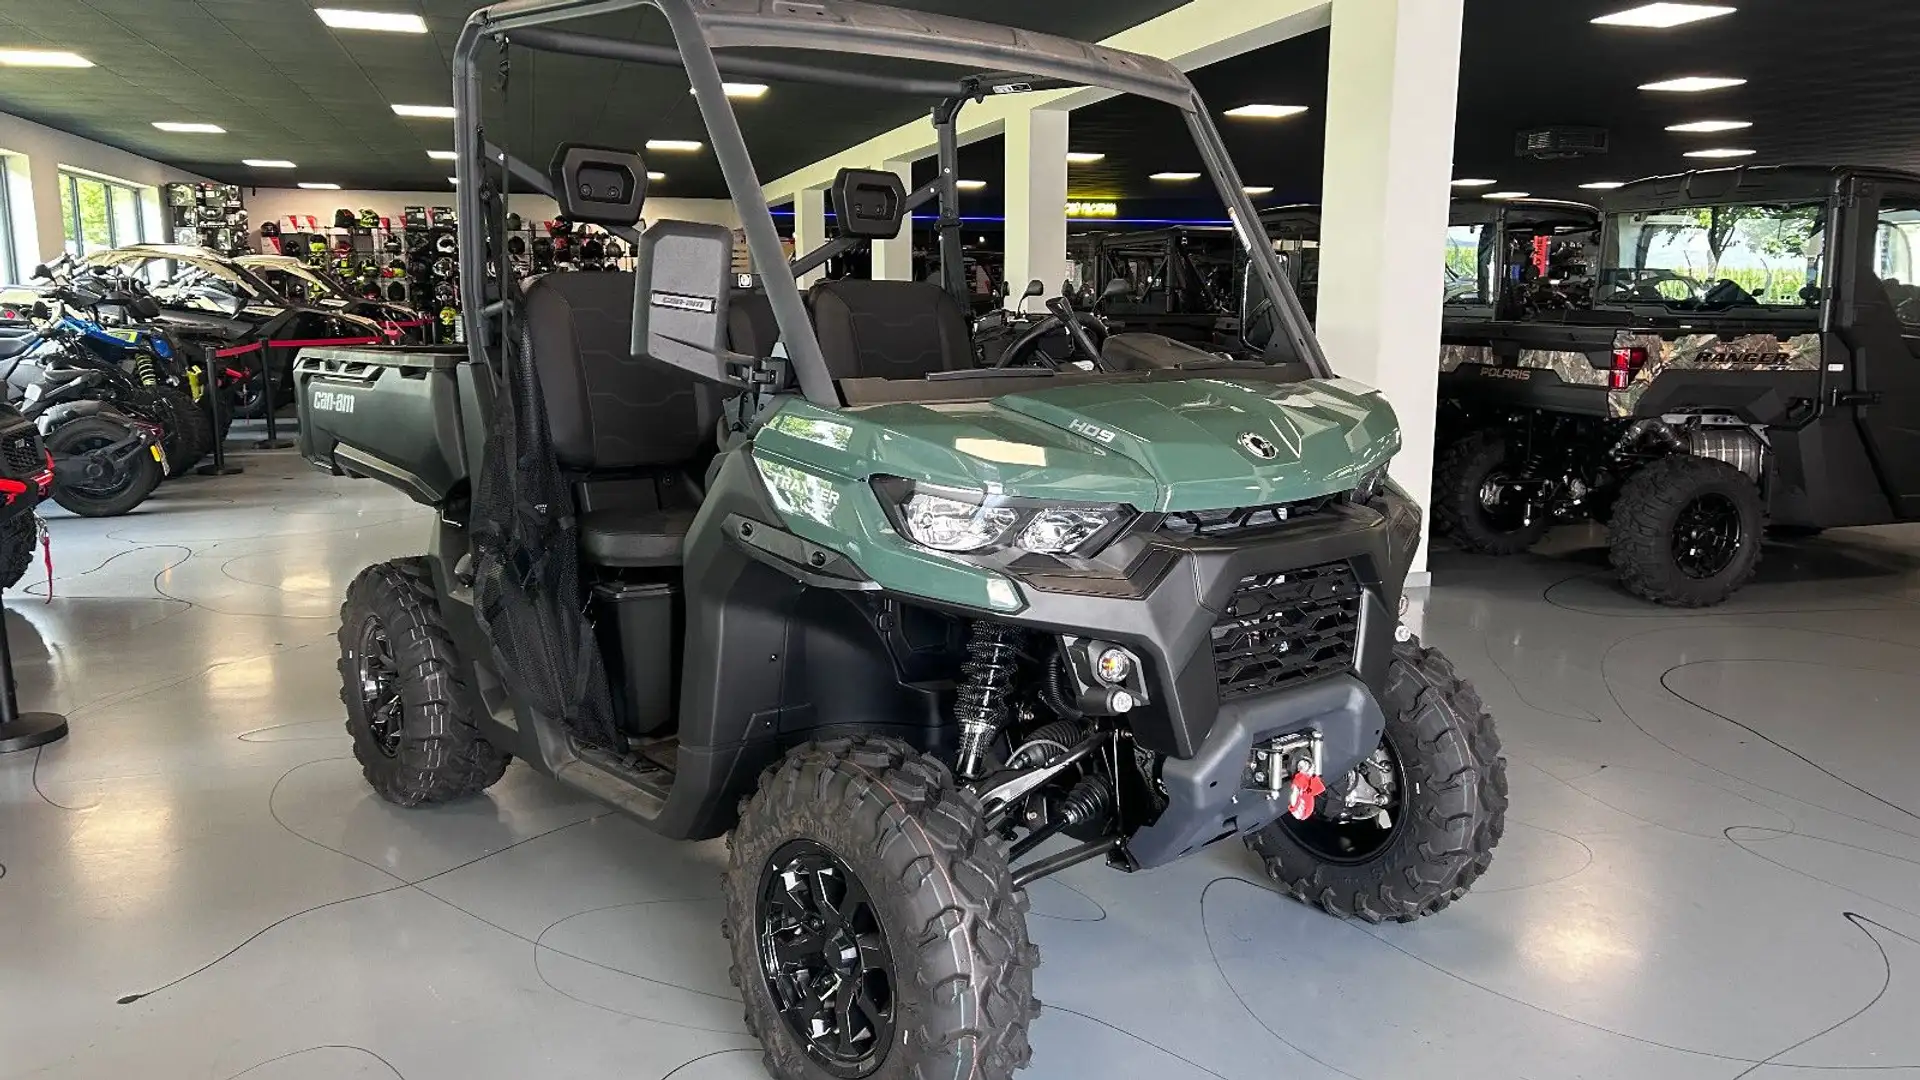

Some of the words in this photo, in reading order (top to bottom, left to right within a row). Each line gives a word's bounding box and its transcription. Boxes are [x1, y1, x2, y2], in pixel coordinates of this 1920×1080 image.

[1694, 352, 1791, 365] RANGER
[1480, 366, 1531, 380] POLARIS
[1069, 418, 1116, 443] HD9
